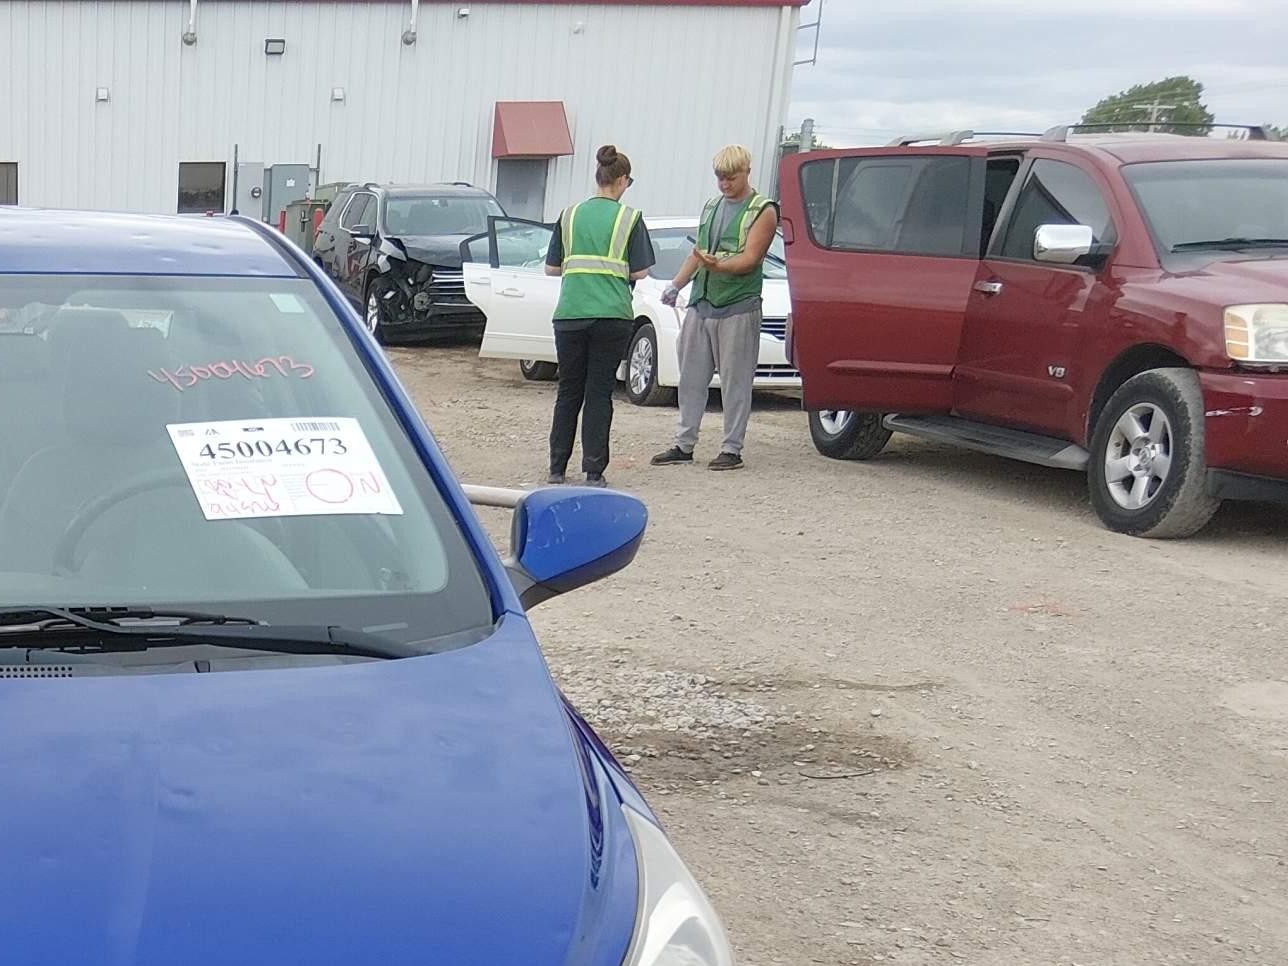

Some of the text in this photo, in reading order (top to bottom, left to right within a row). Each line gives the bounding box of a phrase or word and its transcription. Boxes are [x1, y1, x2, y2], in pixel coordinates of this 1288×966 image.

[147, 355, 314, 392] 45004673
[1047, 365, 1066, 378] V8
[199, 438, 348, 460] 45004673
